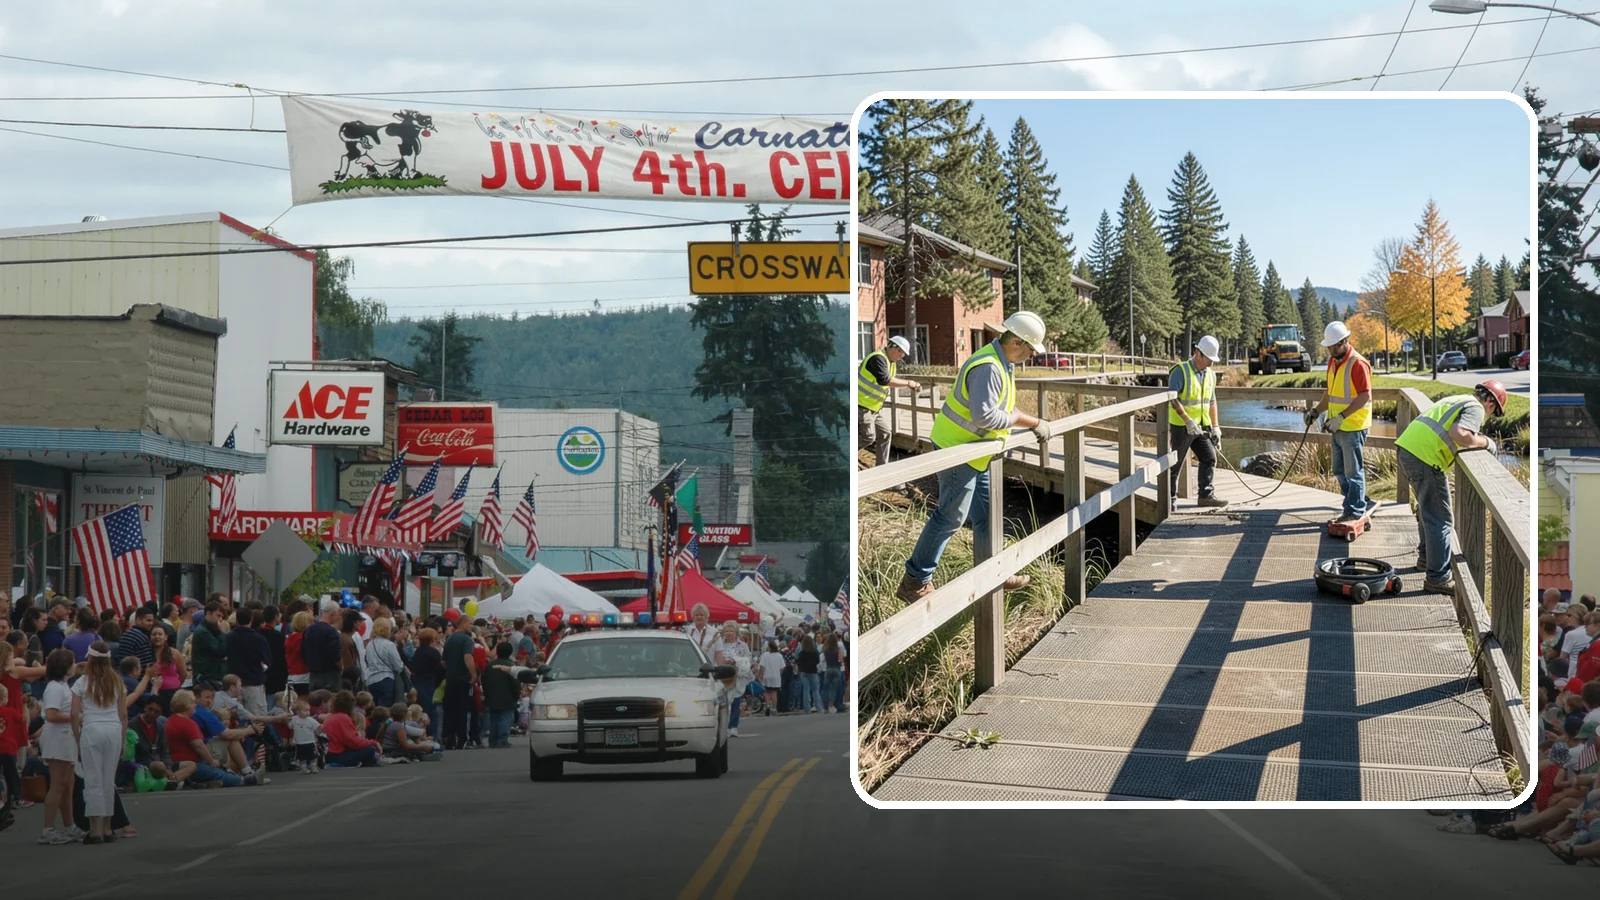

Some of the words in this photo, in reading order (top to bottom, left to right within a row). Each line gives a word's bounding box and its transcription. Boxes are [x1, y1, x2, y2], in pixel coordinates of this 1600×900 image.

[481, 141, 604, 192] JULY
[632, 150, 746, 197] 4th.
[697, 254, 850, 280] CROSSWA
[283, 380, 373, 420] ACE
[406, 409, 452, 422] CEDAR
[283, 421, 370, 436] Hardware
[416, 428, 476, 447] Coca-Cola
[353, 467, 385, 480] Simpl
[83, 485, 94, 494] St.
[95, 485, 125, 495] Vincent
[126, 486, 136, 495] de
[137, 486, 155, 495] Paul
[688, 526, 741, 535] CRNATION
[699, 535, 730, 543] GLASS
